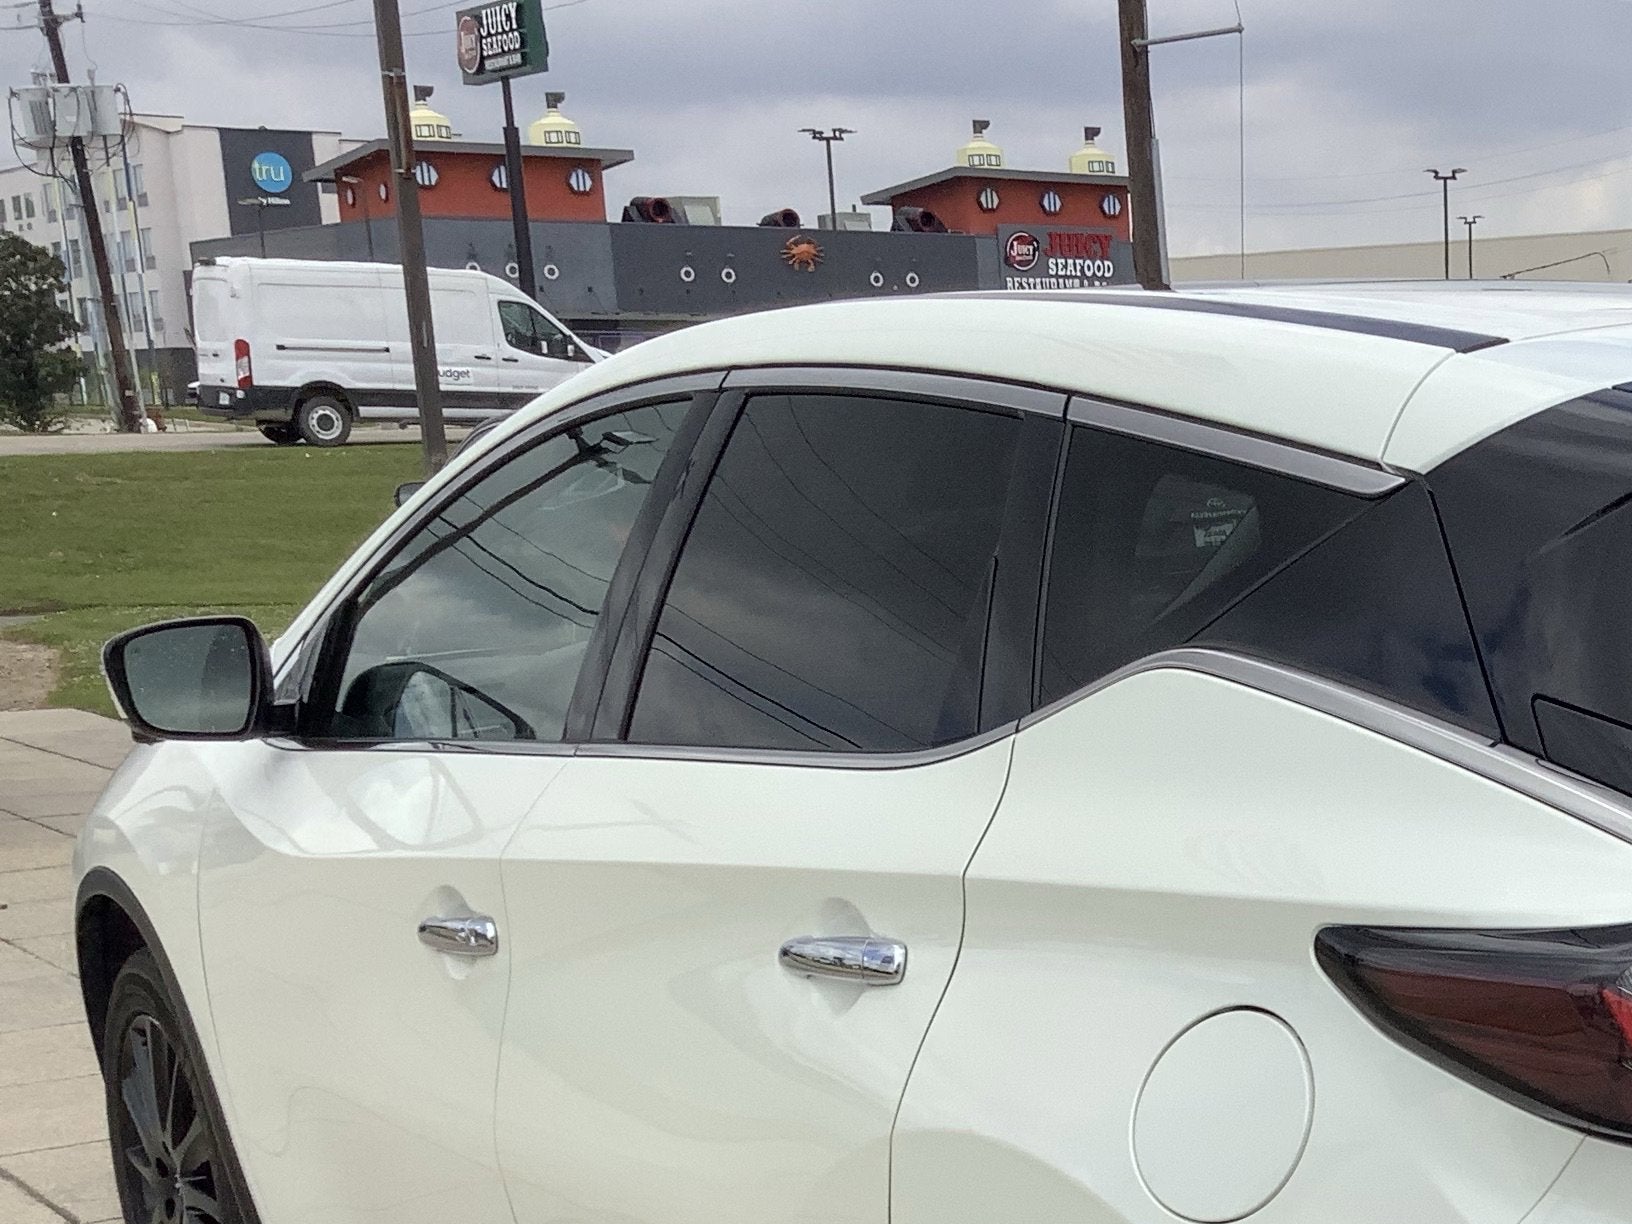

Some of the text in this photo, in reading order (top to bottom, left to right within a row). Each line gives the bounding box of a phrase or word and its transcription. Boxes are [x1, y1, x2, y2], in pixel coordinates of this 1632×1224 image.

[480, 2, 517, 36] JUICY
[481, 31, 521, 56] SEAFOOD
[252, 160, 285, 181] tru
[1043, 231, 1112, 258] JUICY
[1048, 258, 1114, 277] SEAFOOD
